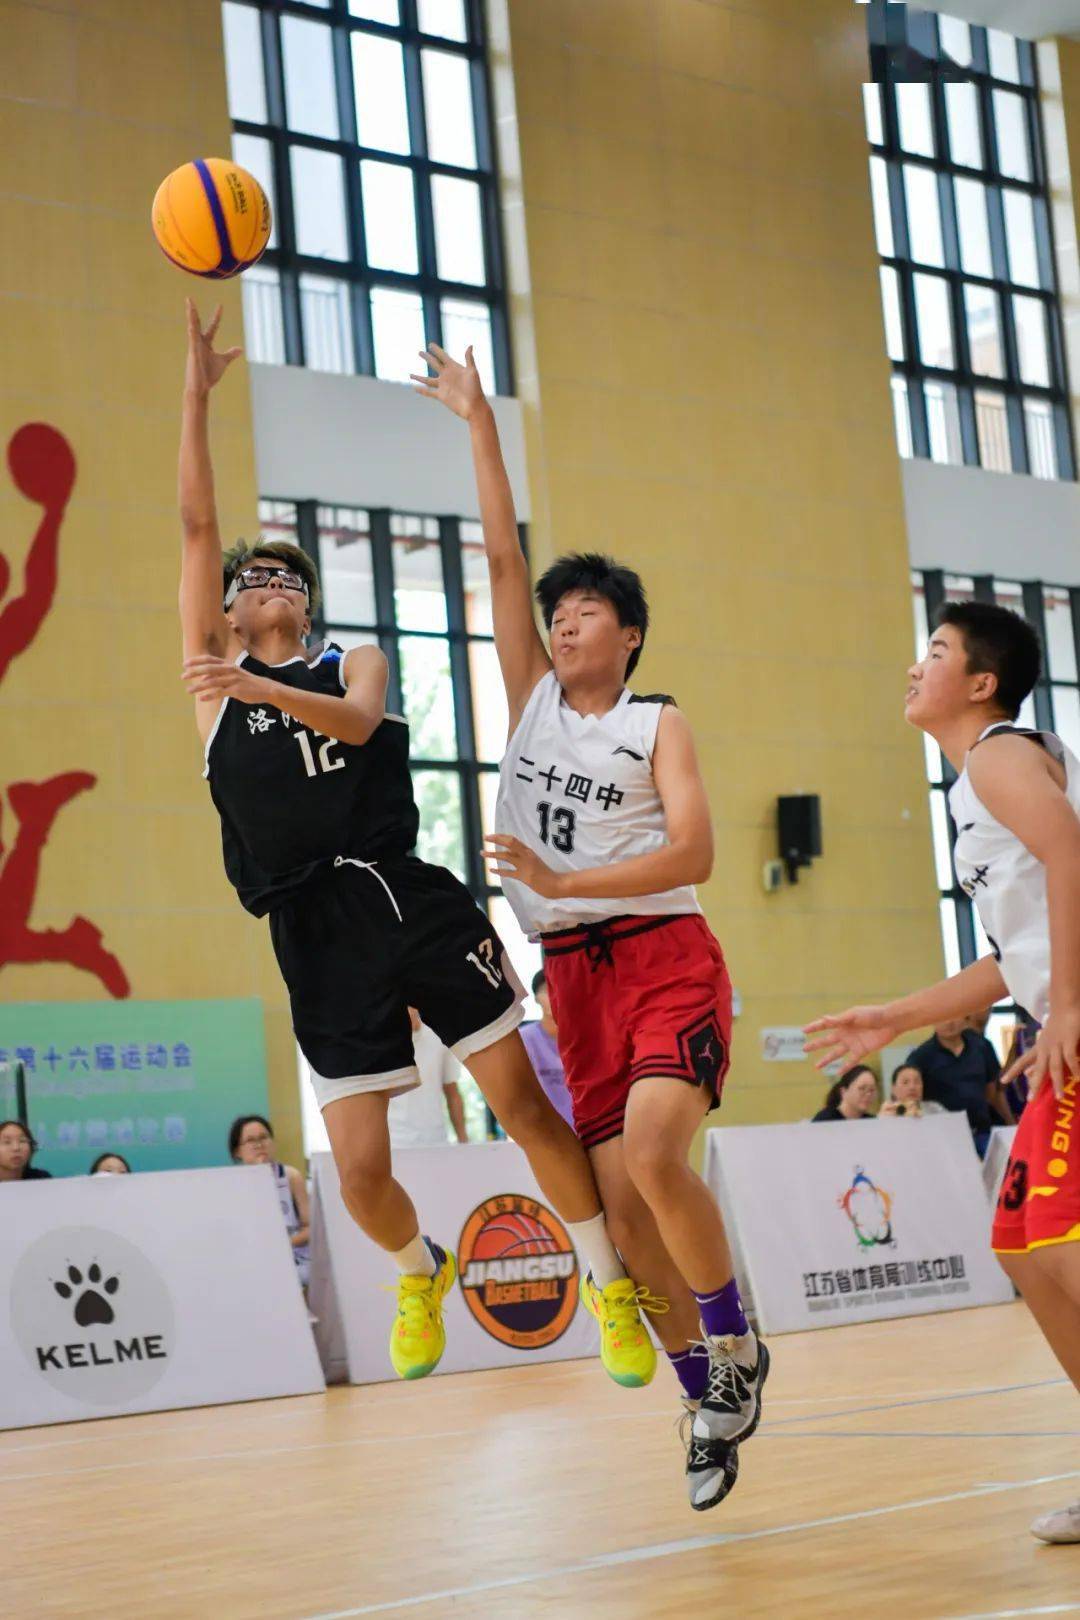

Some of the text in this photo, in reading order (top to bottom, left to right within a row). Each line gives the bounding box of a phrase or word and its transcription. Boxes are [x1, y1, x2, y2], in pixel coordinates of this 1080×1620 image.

[294, 730, 346, 777] 12
[516, 756, 624, 811] 二十四中
[536, 800, 576, 855] 13
[465, 938, 502, 989] 12
[997, 1155, 1028, 1211] 3
[463, 1253, 574, 1288] JIANGSU
[803, 1254, 966, 1298] 江苏省体育局训练中心
[36, 1335, 167, 1371] KELME
